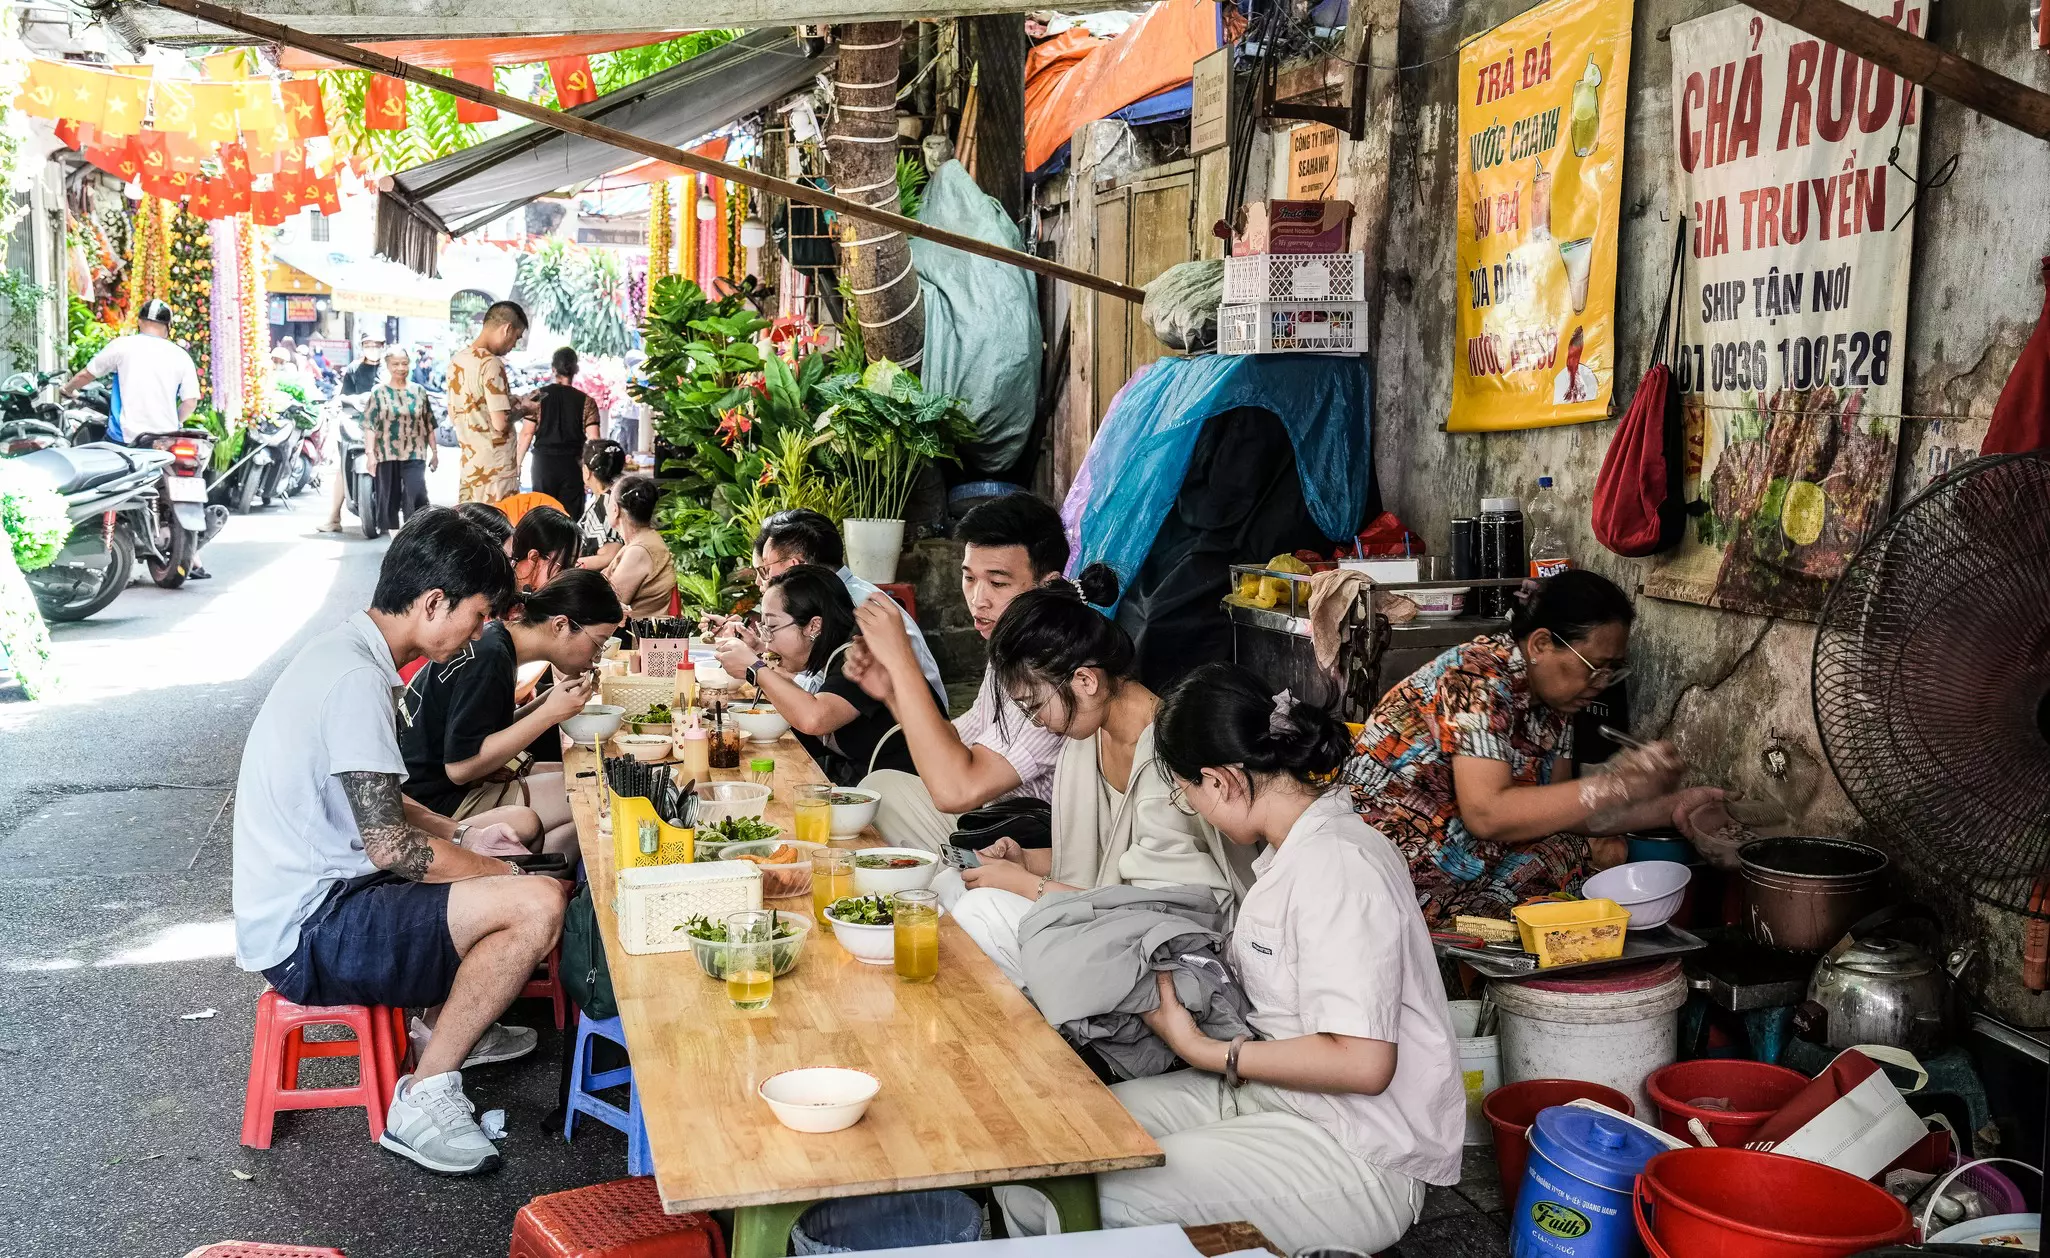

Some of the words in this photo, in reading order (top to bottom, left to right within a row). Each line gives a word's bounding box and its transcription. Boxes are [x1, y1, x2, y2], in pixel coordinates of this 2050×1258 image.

[1475, 48, 1515, 106] TRÀ
[1522, 31, 1552, 90] ĐÁ
[1679, 16, 1763, 174] CHẢ
[1294, 133, 1311, 152] CÔNG
[1311, 132, 1319, 148] TY
[1470, 117, 1506, 173] NƯỚC
[1509, 106, 1561, 162] CHANH
[1495, 181, 1519, 234] ĐÁ
[1740, 149, 1887, 251] TRUYỀN
[1702, 279, 1746, 324] SHIP
[1752, 266, 1804, 325] TẬN
[1812, 262, 1852, 313] NƠI
[1711, 339, 1768, 392] 0936
[1536, 1203, 1581, 1235] Faith
